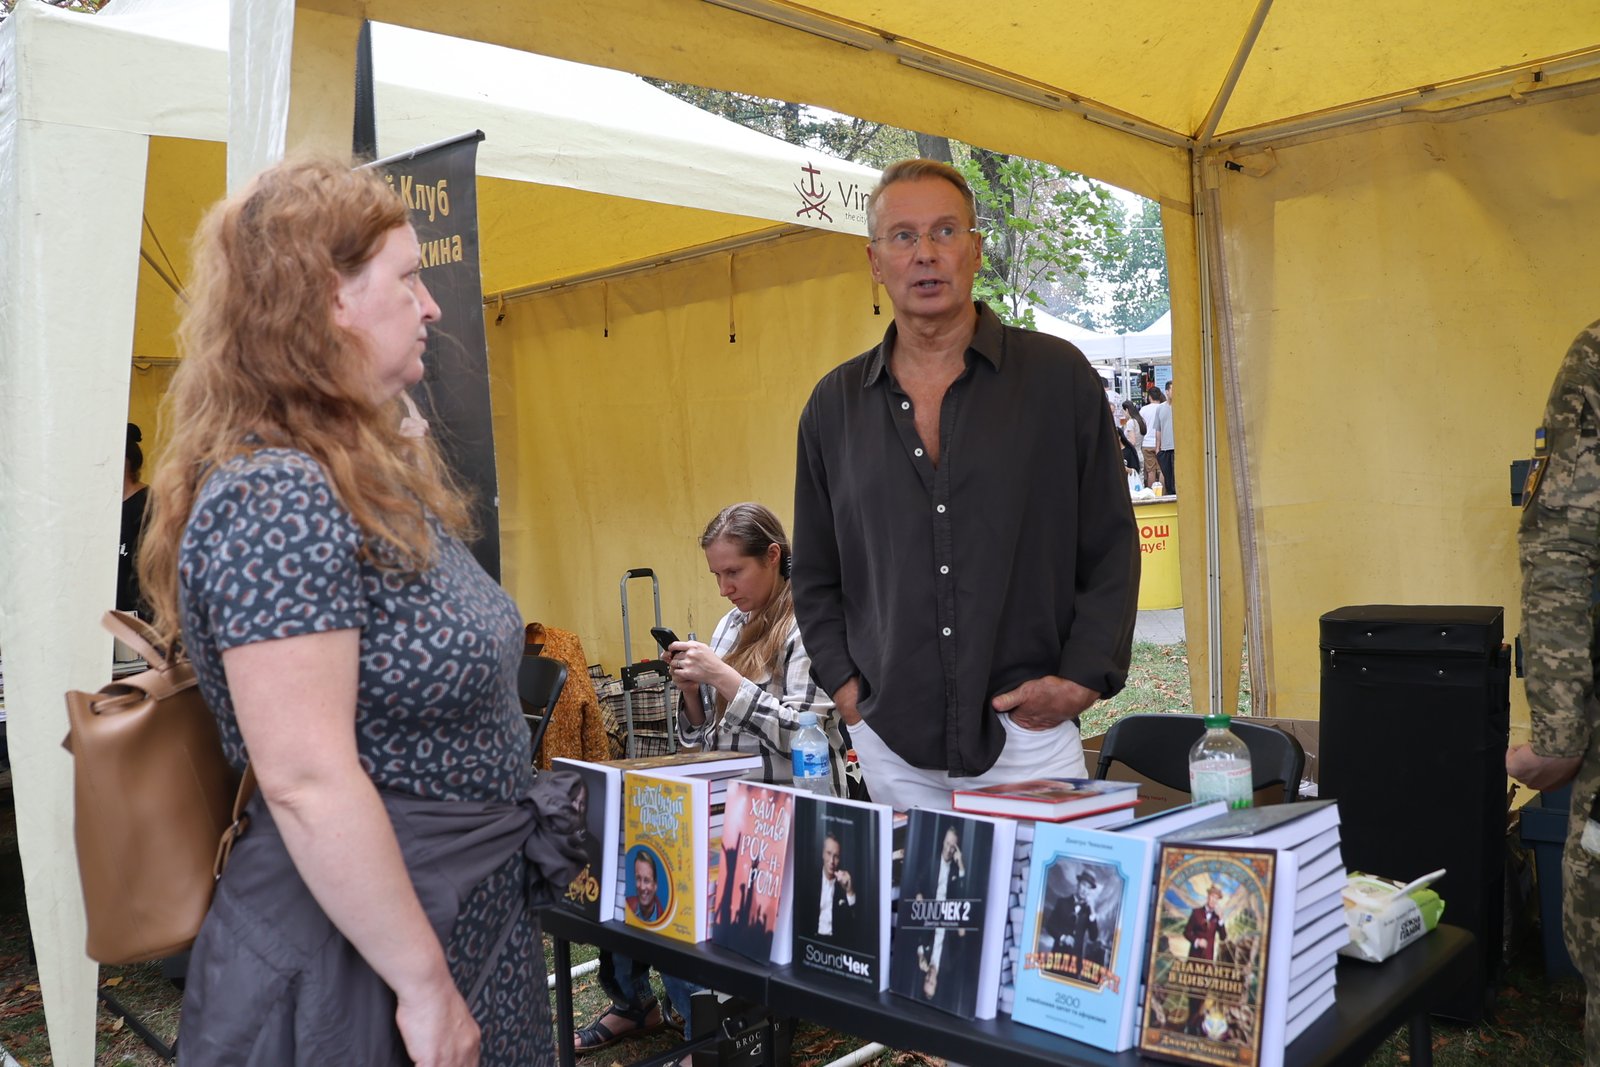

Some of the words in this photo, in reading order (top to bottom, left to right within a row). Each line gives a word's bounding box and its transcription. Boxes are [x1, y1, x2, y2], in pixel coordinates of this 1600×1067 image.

[400, 175, 449, 222] Клуб
[845, 212, 856, 221] the
[1138, 524, 1169, 539] ОШ
[961, 901, 971, 921] 2
[805, 944, 870, 976] SoundЧек
[1023, 951, 1078, 974] ПРАВИЛА
[1172, 961, 1241, 981] ДІАМАНТИ
[1055, 992, 1080, 1009] 2500
[735, 1023, 780, 1049] BROCD
